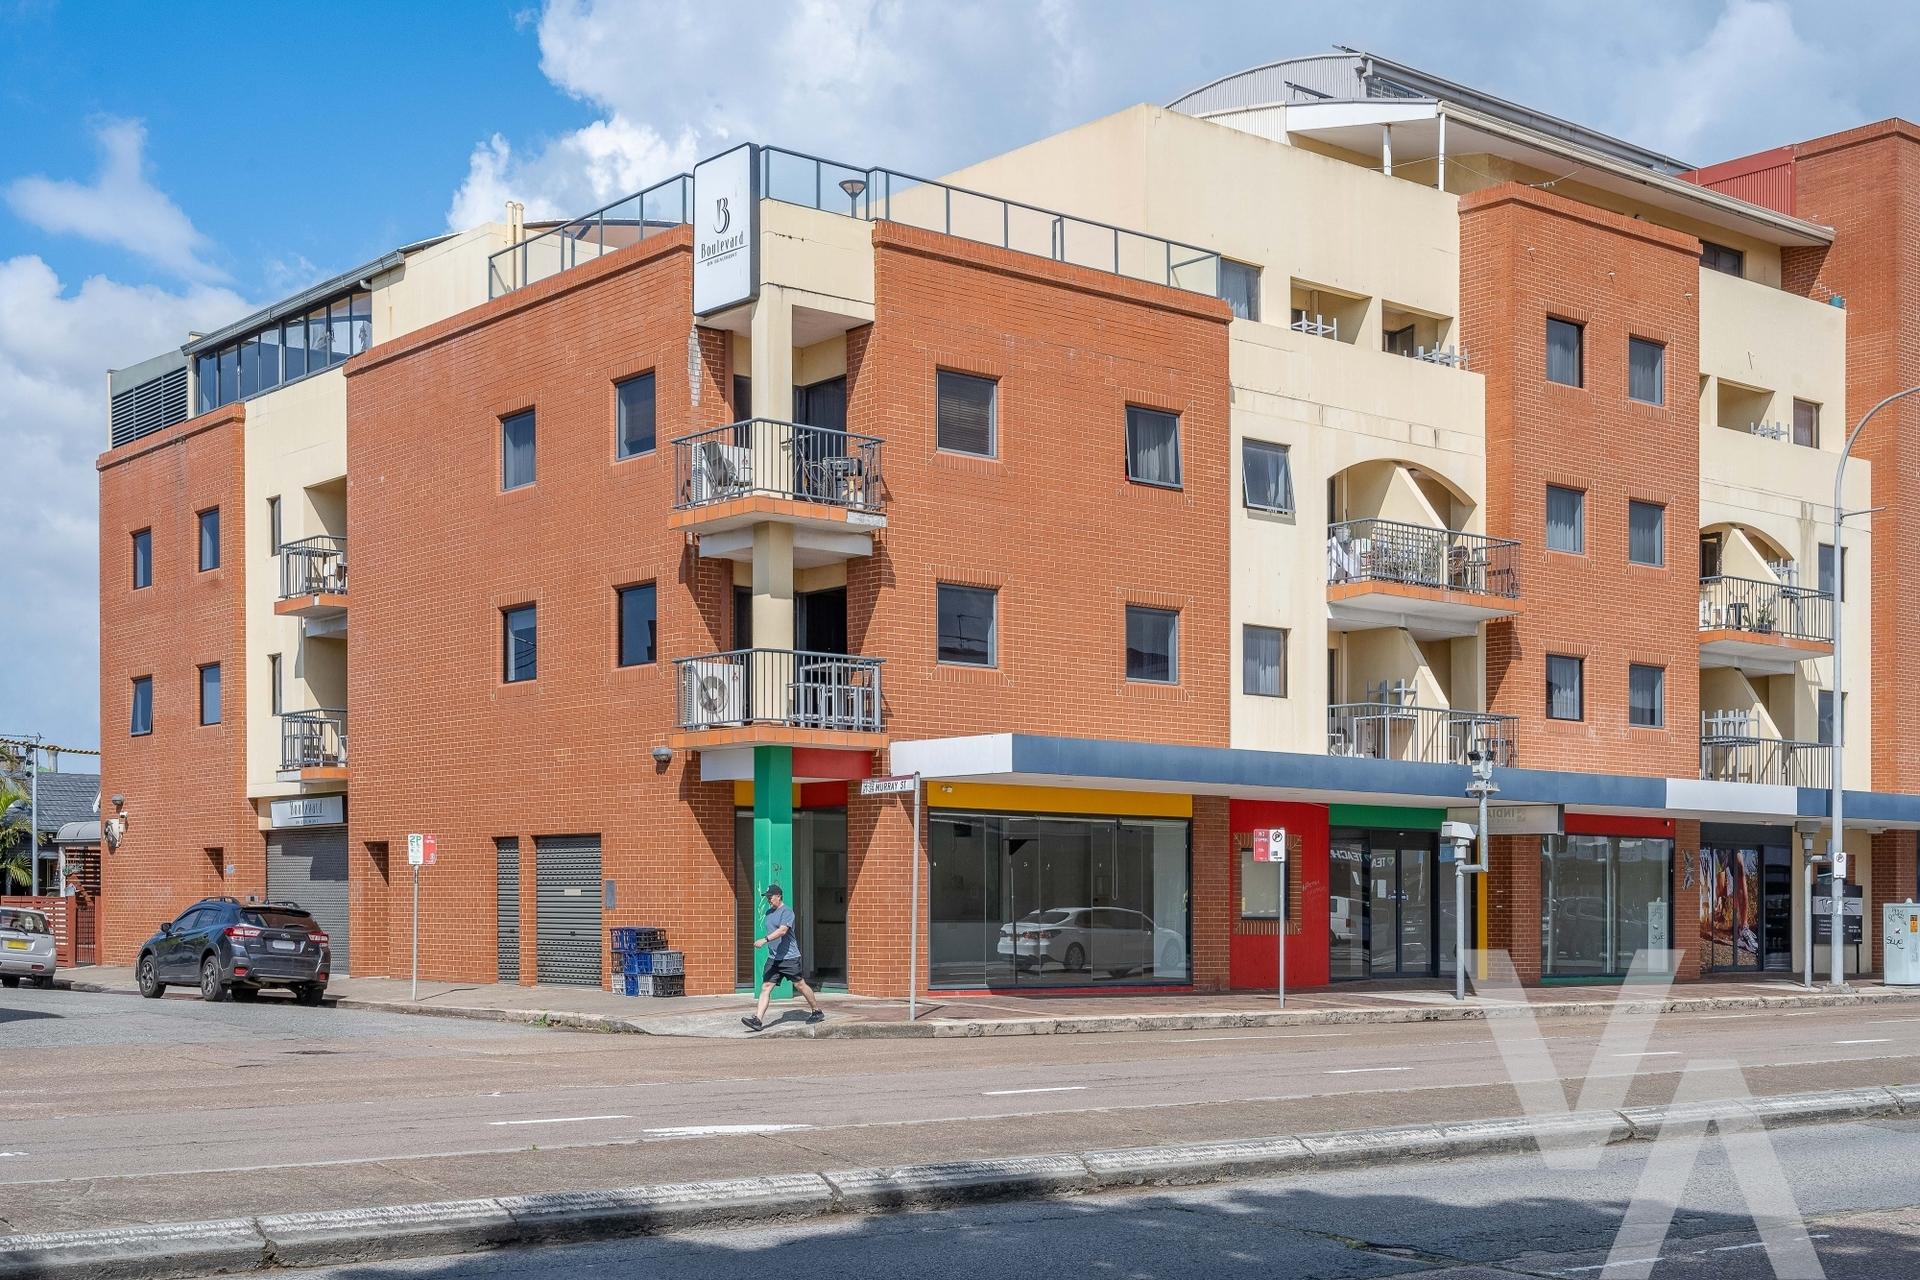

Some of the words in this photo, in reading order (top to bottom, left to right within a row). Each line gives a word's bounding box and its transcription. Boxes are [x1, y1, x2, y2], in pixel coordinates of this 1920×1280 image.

[701, 231, 744, 259] Boulevard
[875, 781, 899, 792] MURRAY
[900, 780, 907, 790] ST
